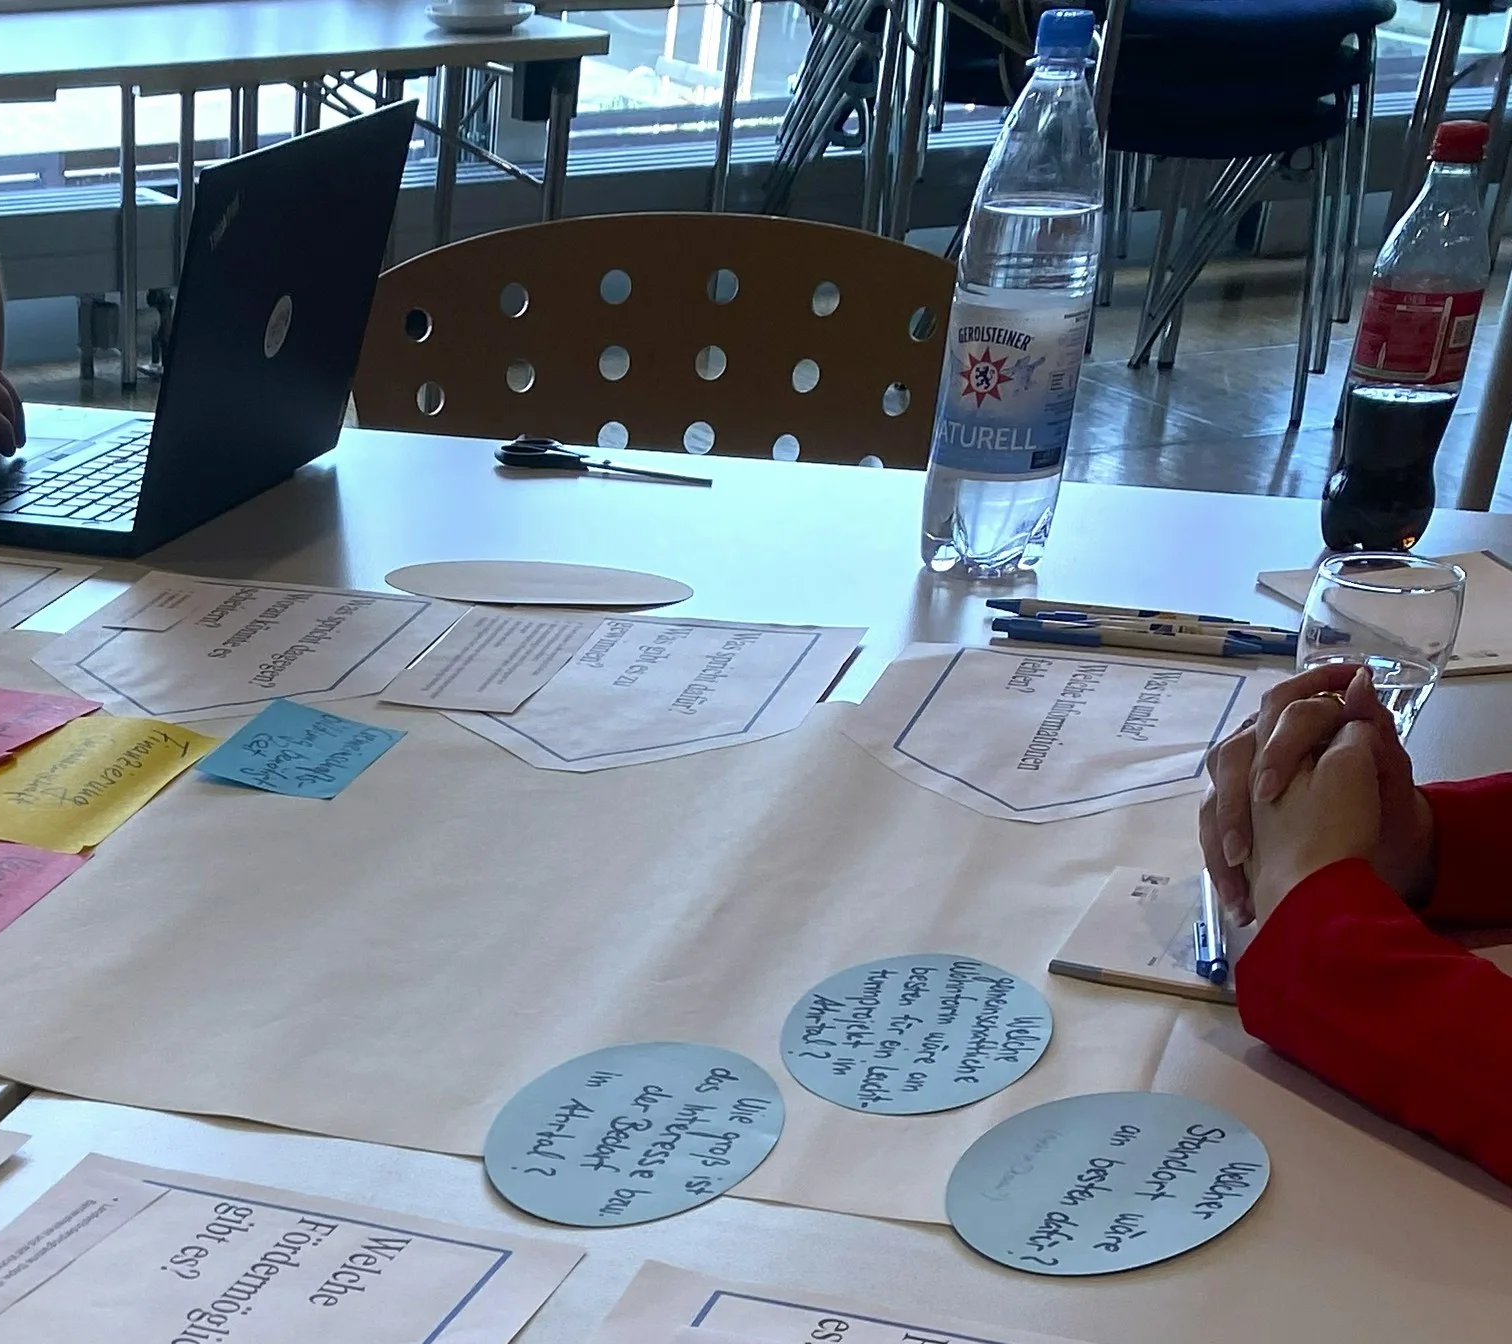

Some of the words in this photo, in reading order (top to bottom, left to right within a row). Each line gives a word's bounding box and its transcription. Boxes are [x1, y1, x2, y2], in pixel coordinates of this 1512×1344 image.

[958, 326, 1031, 351] GEROLSTEINER
[937, 419, 1037, 451] ATURELL
[259, 590, 313, 618] Woran
[334, 596, 376, 615] Was
[222, 619, 279, 647] könnte
[298, 616, 345, 644] spricht
[576, 620, 634, 668] gewinnen?
[653, 626, 693, 644] Was
[722, 633, 762, 650] Was
[208, 648, 232, 658] es
[249, 645, 316, 688] dagegen?
[635, 646, 671, 663] gibt
[694, 652, 736, 683] spricht
[613, 675, 638, 686] zu
[625, 665, 648, 674] es
[1006, 658, 1053, 693] fehlen?
[1061, 665, 1108, 698] Welche
[1144, 672, 1182, 691] Was
[668, 684, 715, 715] dafür?
[1136, 692, 1171, 704] ist
[1017, 699, 1086, 770] Informationen
[1117, 706, 1158, 741] unklar?
[40, 730, 190, 806] Finanzierung
[899, 967, 938, 1006] besten
[938, 962, 982, 1024] Wohnform
[833, 969, 897, 1048] turmprojekt
[888, 1015, 923, 1035] für
[954, 977, 1015, 1083] gemeinschaftliche
[994, 1017, 1044, 1062] Welche
[874, 1040, 908, 1058] ein
[914, 1033, 949, 1064] wäre
[695, 1068, 739, 1092] das
[832, 1058, 866, 1075] im
[902, 1072, 927, 1092] am
[631, 1085, 673, 1113] der
[729, 1098, 771, 1124] Wie
[580, 1116, 652, 1172] Bedarf
[629, 1104, 717, 1178] Interesse
[1110, 1125, 1140, 1146] am
[1135, 1125, 1225, 1200] Standort
[685, 1176, 721, 1195] ist
[1061, 1158, 1124, 1205] besten
[1193, 1163, 1261, 1220] Welcher
[196, 1203, 254, 1243] gibt
[1093, 1214, 1147, 1252] wäre
[161, 1246, 208, 1279] es?
[309, 1238, 412, 1306] Welche
